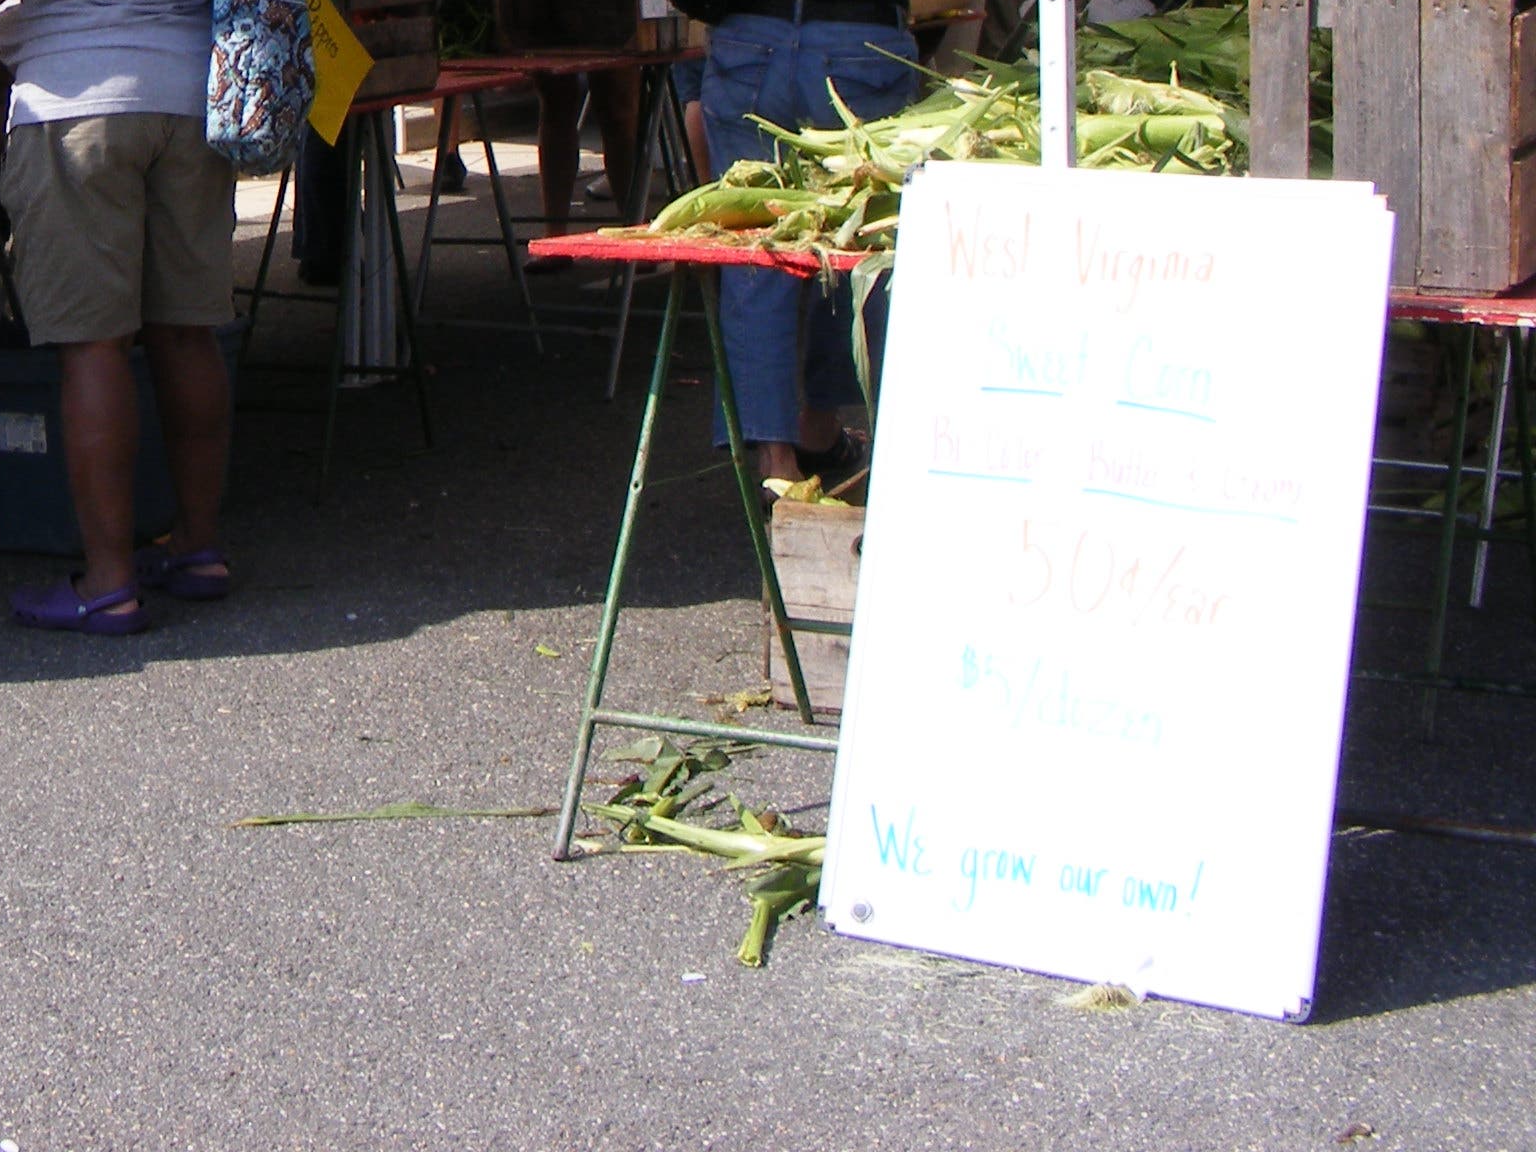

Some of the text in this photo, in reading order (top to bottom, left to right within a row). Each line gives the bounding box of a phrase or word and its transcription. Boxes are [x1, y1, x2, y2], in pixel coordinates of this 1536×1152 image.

[945, 200, 1216, 315] West Virginia
[980, 314, 1212, 405] Sweet Corn
[870, 803, 1206, 919] We grow our own!
